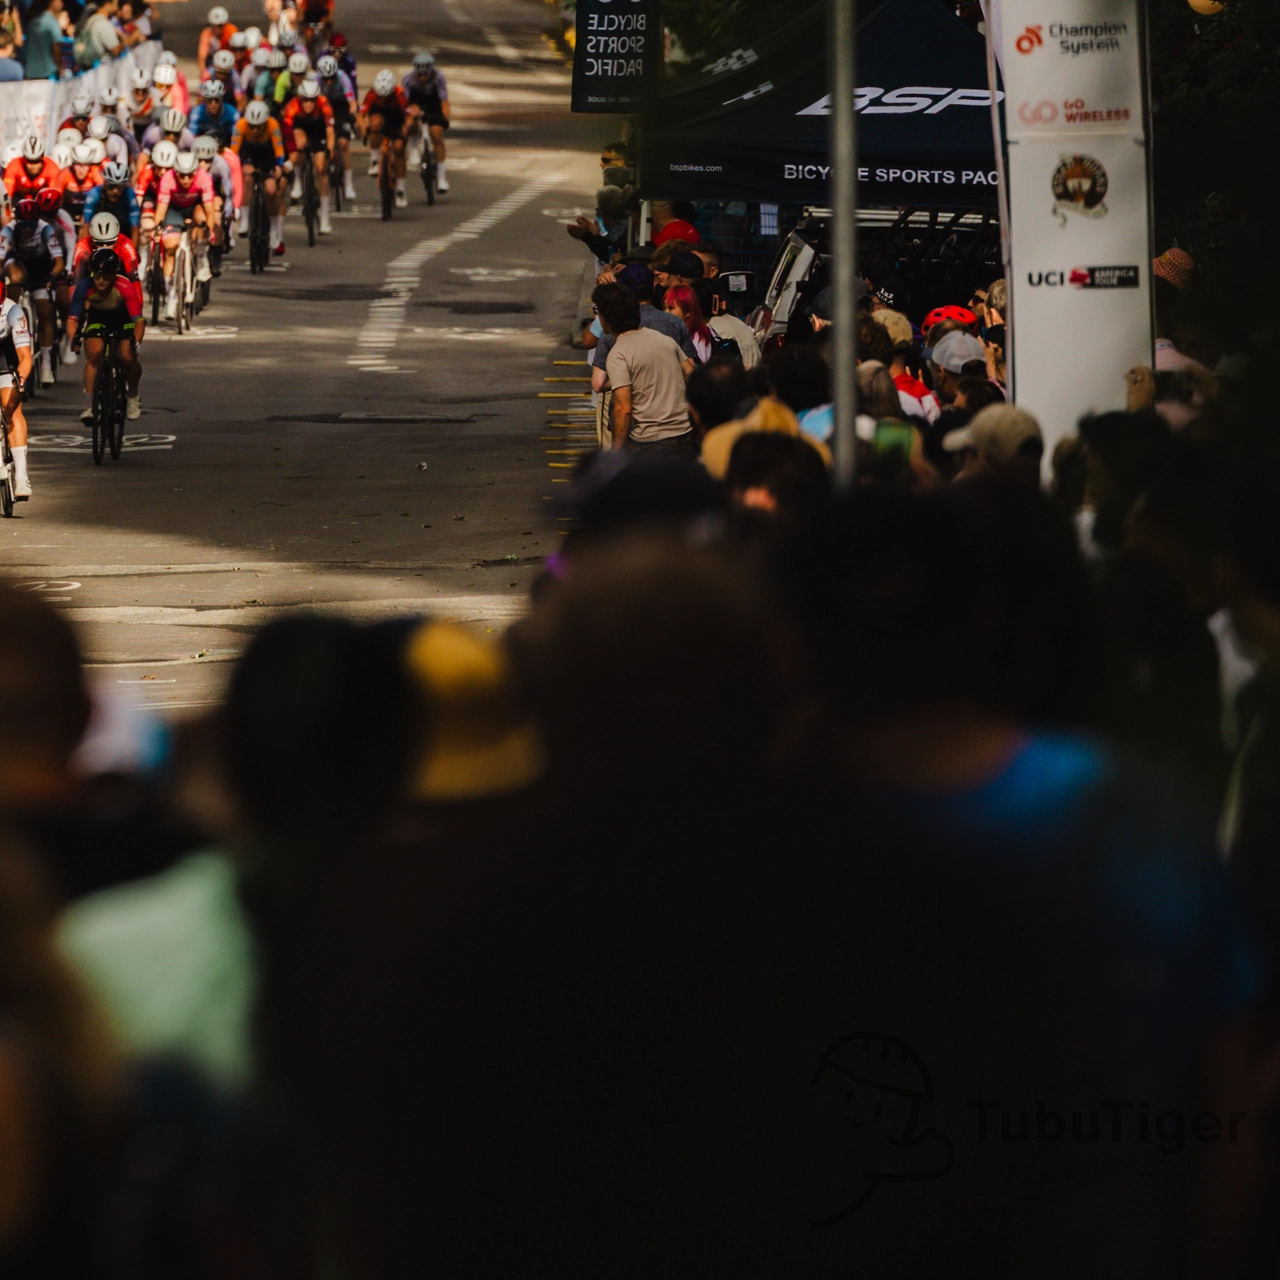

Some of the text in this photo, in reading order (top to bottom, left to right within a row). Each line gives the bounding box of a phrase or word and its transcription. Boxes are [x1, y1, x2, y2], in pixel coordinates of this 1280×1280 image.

[1049, 22, 1127, 38] Champion
[1060, 36, 1121, 56] System
[1064, 108, 1130, 124] WIRELESS
[670, 162, 723, 173] bspbikes.com
[784, 164, 999, 185] BICYE SPORTS PAC
[1027, 272, 1065, 287] UCI
